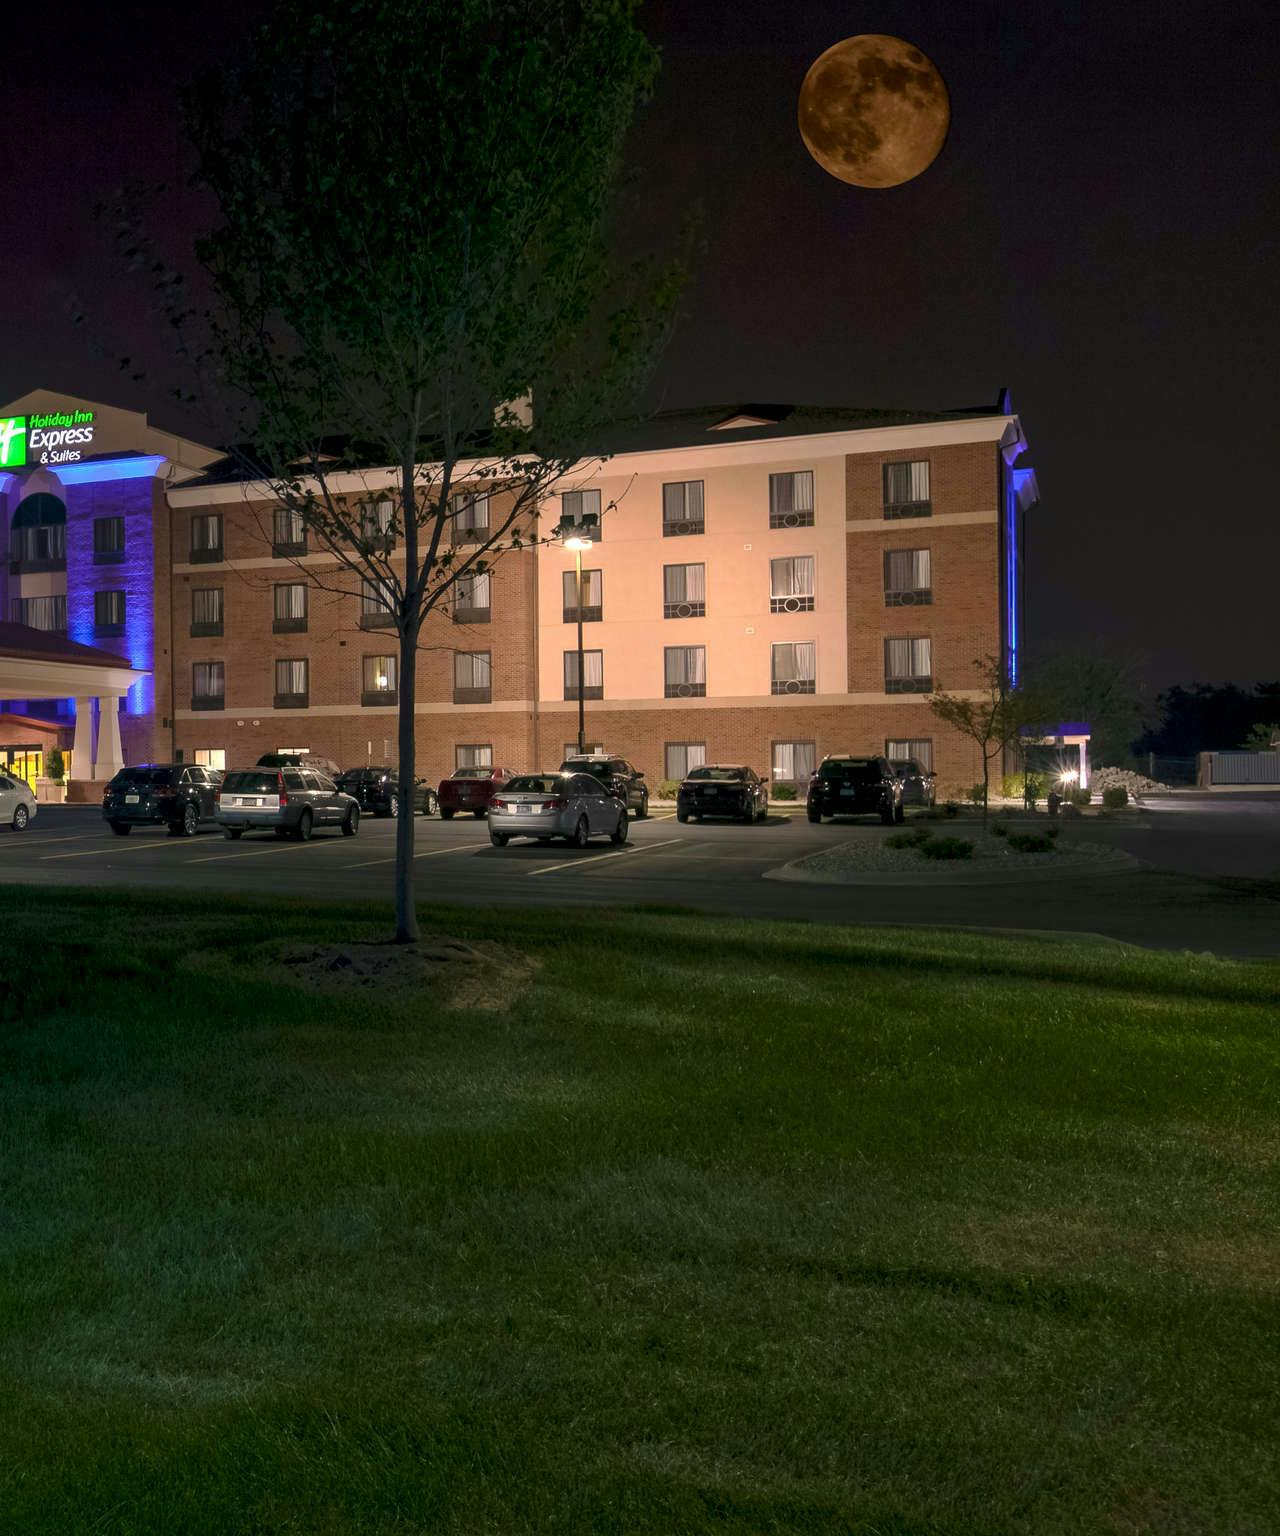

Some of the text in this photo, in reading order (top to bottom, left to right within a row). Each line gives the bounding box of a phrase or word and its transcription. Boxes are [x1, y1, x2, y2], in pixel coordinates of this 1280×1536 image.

[29, 409, 93, 428] Holiday Inn
[29, 427, 93, 451] Express
[40, 449, 80, 464] & Suites
